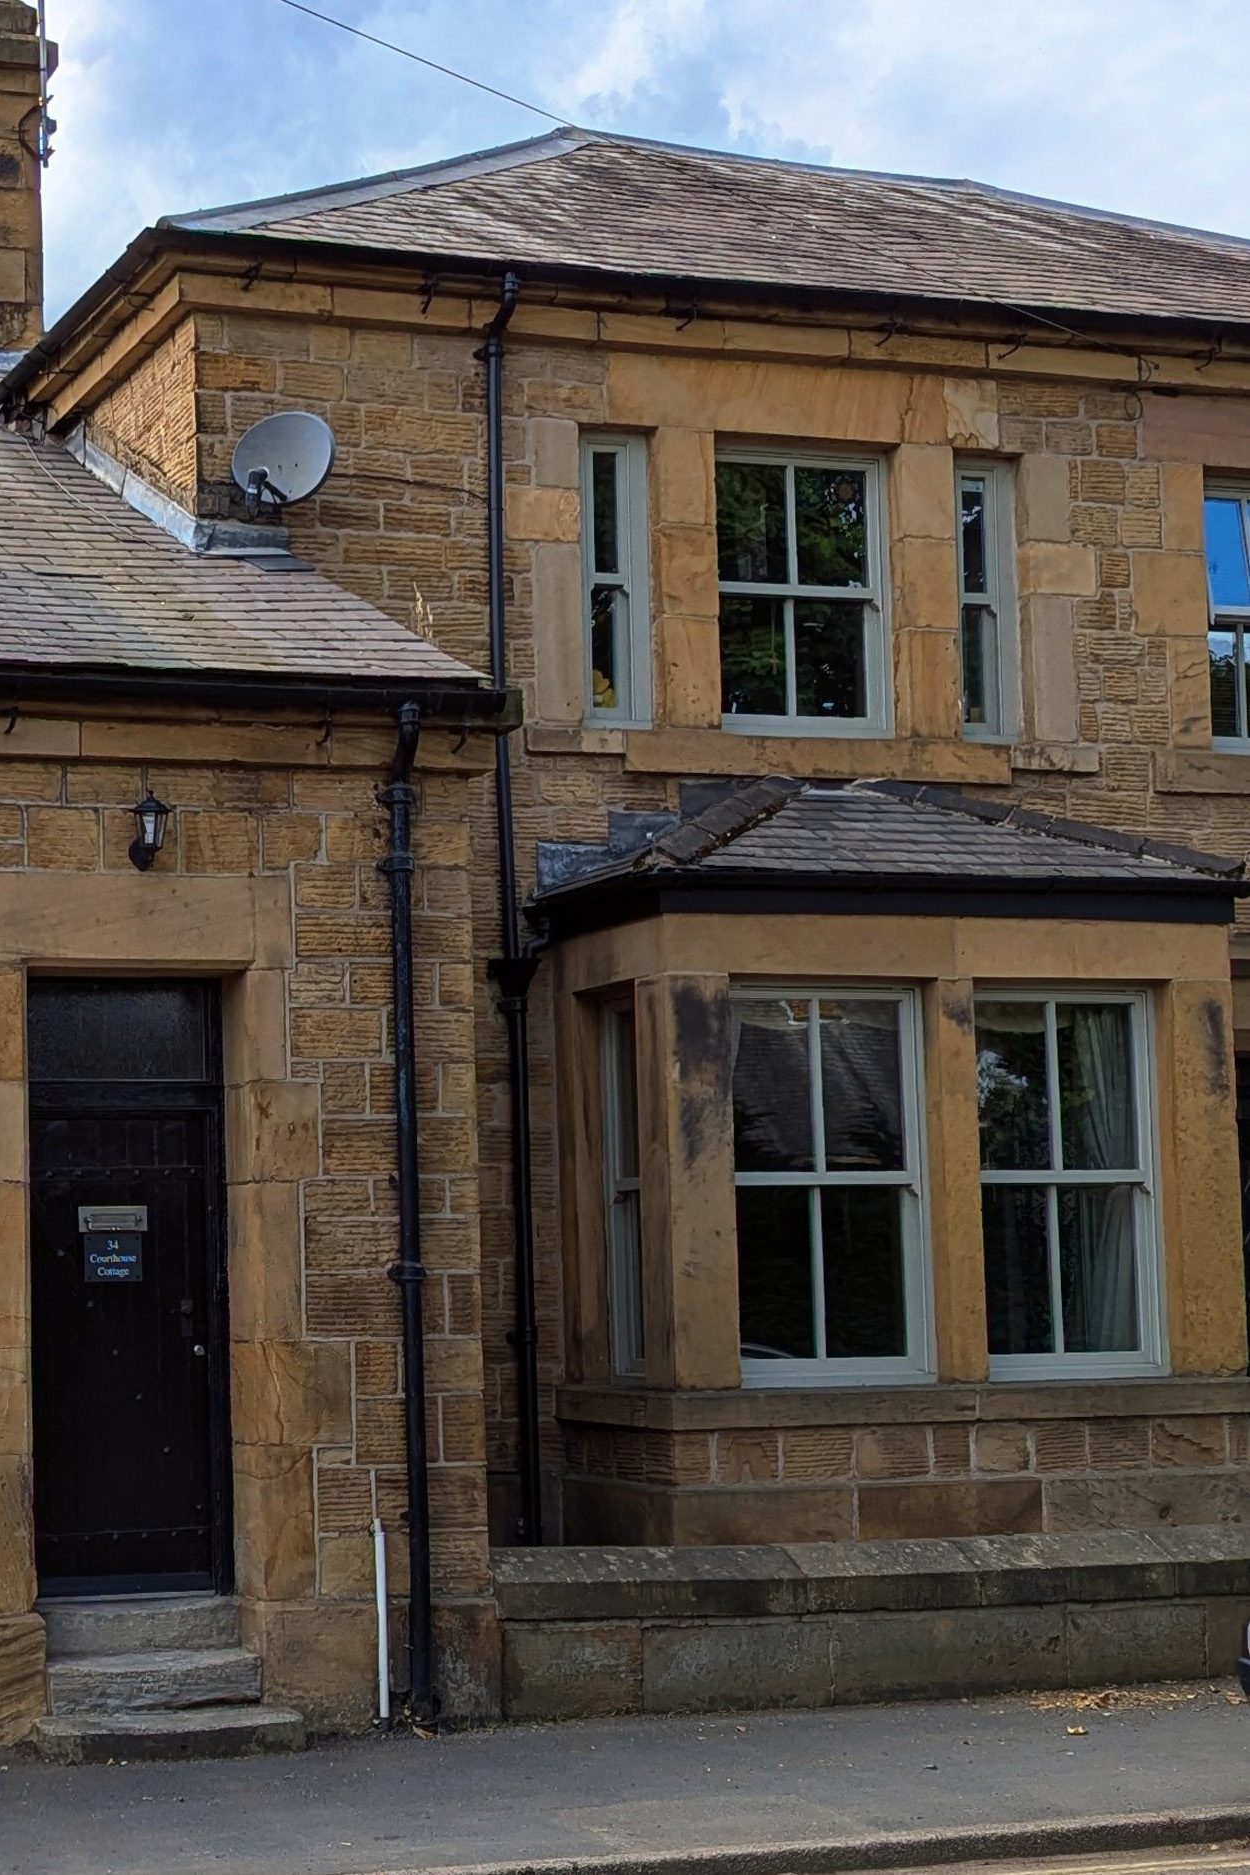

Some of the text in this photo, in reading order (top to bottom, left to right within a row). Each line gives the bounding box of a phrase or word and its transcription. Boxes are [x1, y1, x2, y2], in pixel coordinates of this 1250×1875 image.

[107, 1240, 119, 1250] 34
[90, 1254, 137, 1263] Courthouse
[97, 1267, 130, 1278] Cottage
